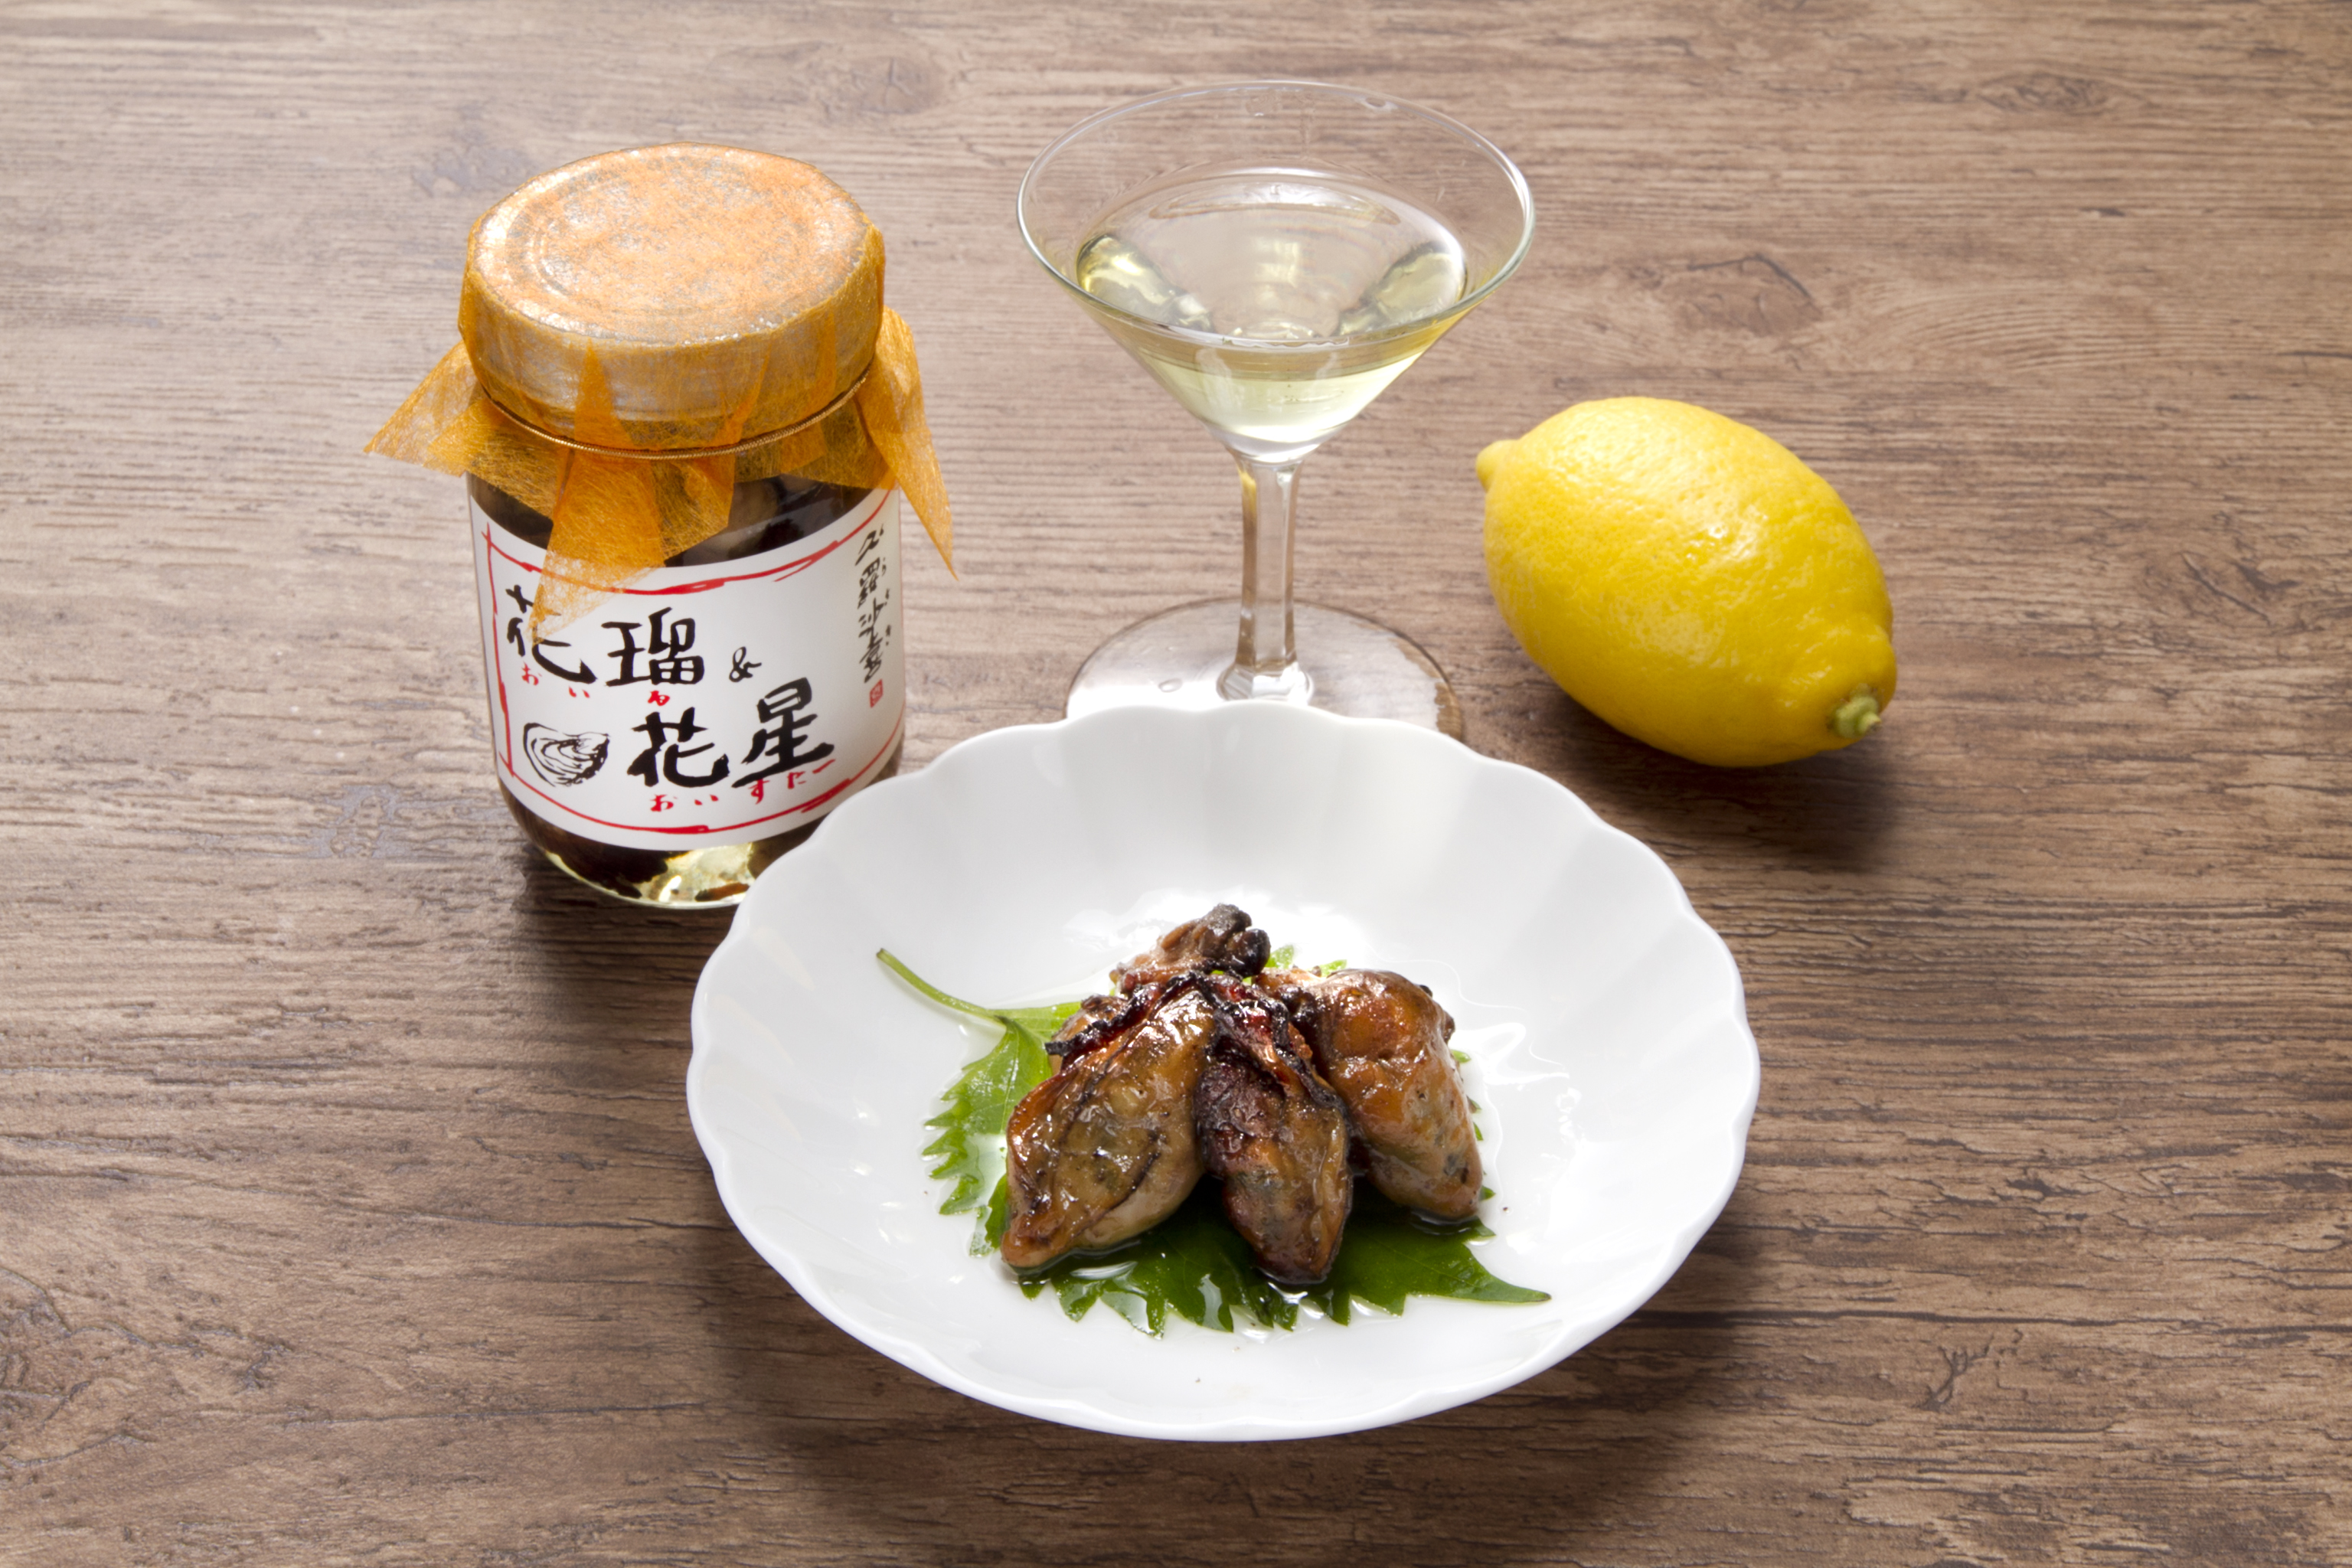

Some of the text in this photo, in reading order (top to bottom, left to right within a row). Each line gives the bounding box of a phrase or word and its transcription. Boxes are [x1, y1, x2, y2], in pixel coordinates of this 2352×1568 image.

[729, 647, 762, 683] &
[627, 677, 835, 788] 花星
[650, 759, 836, 812] おいすたー
